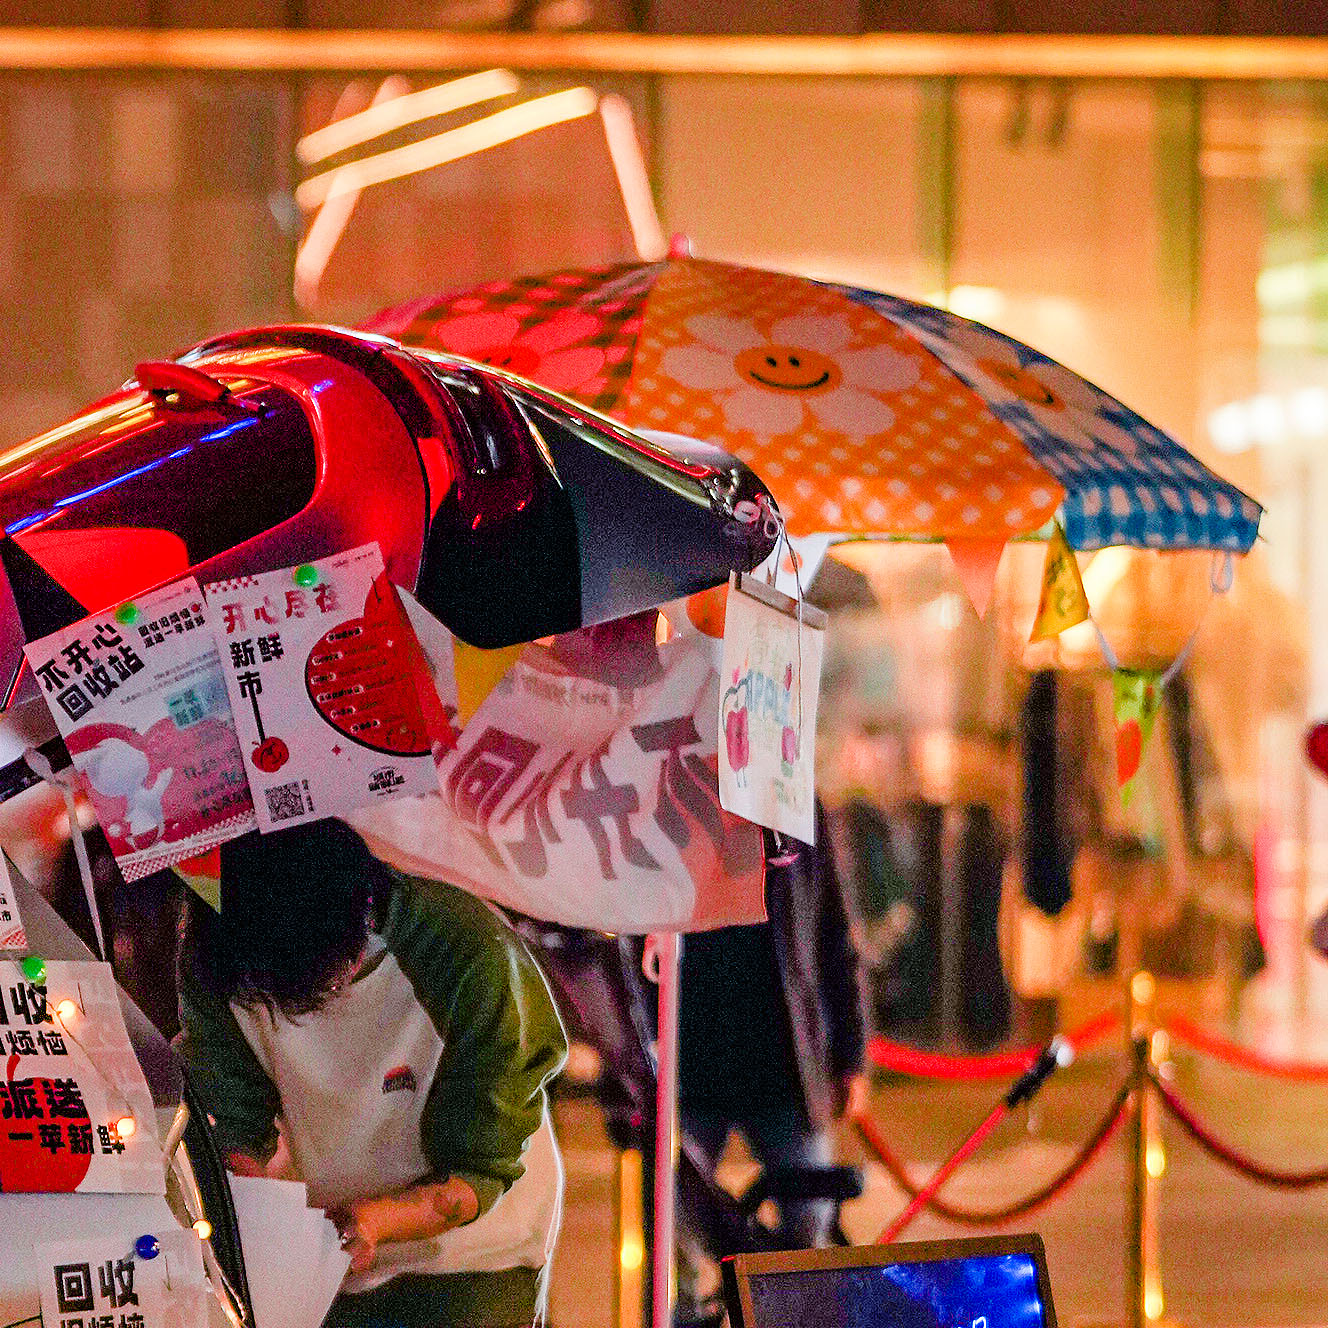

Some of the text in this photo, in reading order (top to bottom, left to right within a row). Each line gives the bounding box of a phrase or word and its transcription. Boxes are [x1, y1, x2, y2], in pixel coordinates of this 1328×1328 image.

[35, 623, 123, 693] 不开心
[229, 631, 284, 670] 新鲜
[56, 645, 145, 722] 回收站
[53, 1259, 140, 1314] 回收
